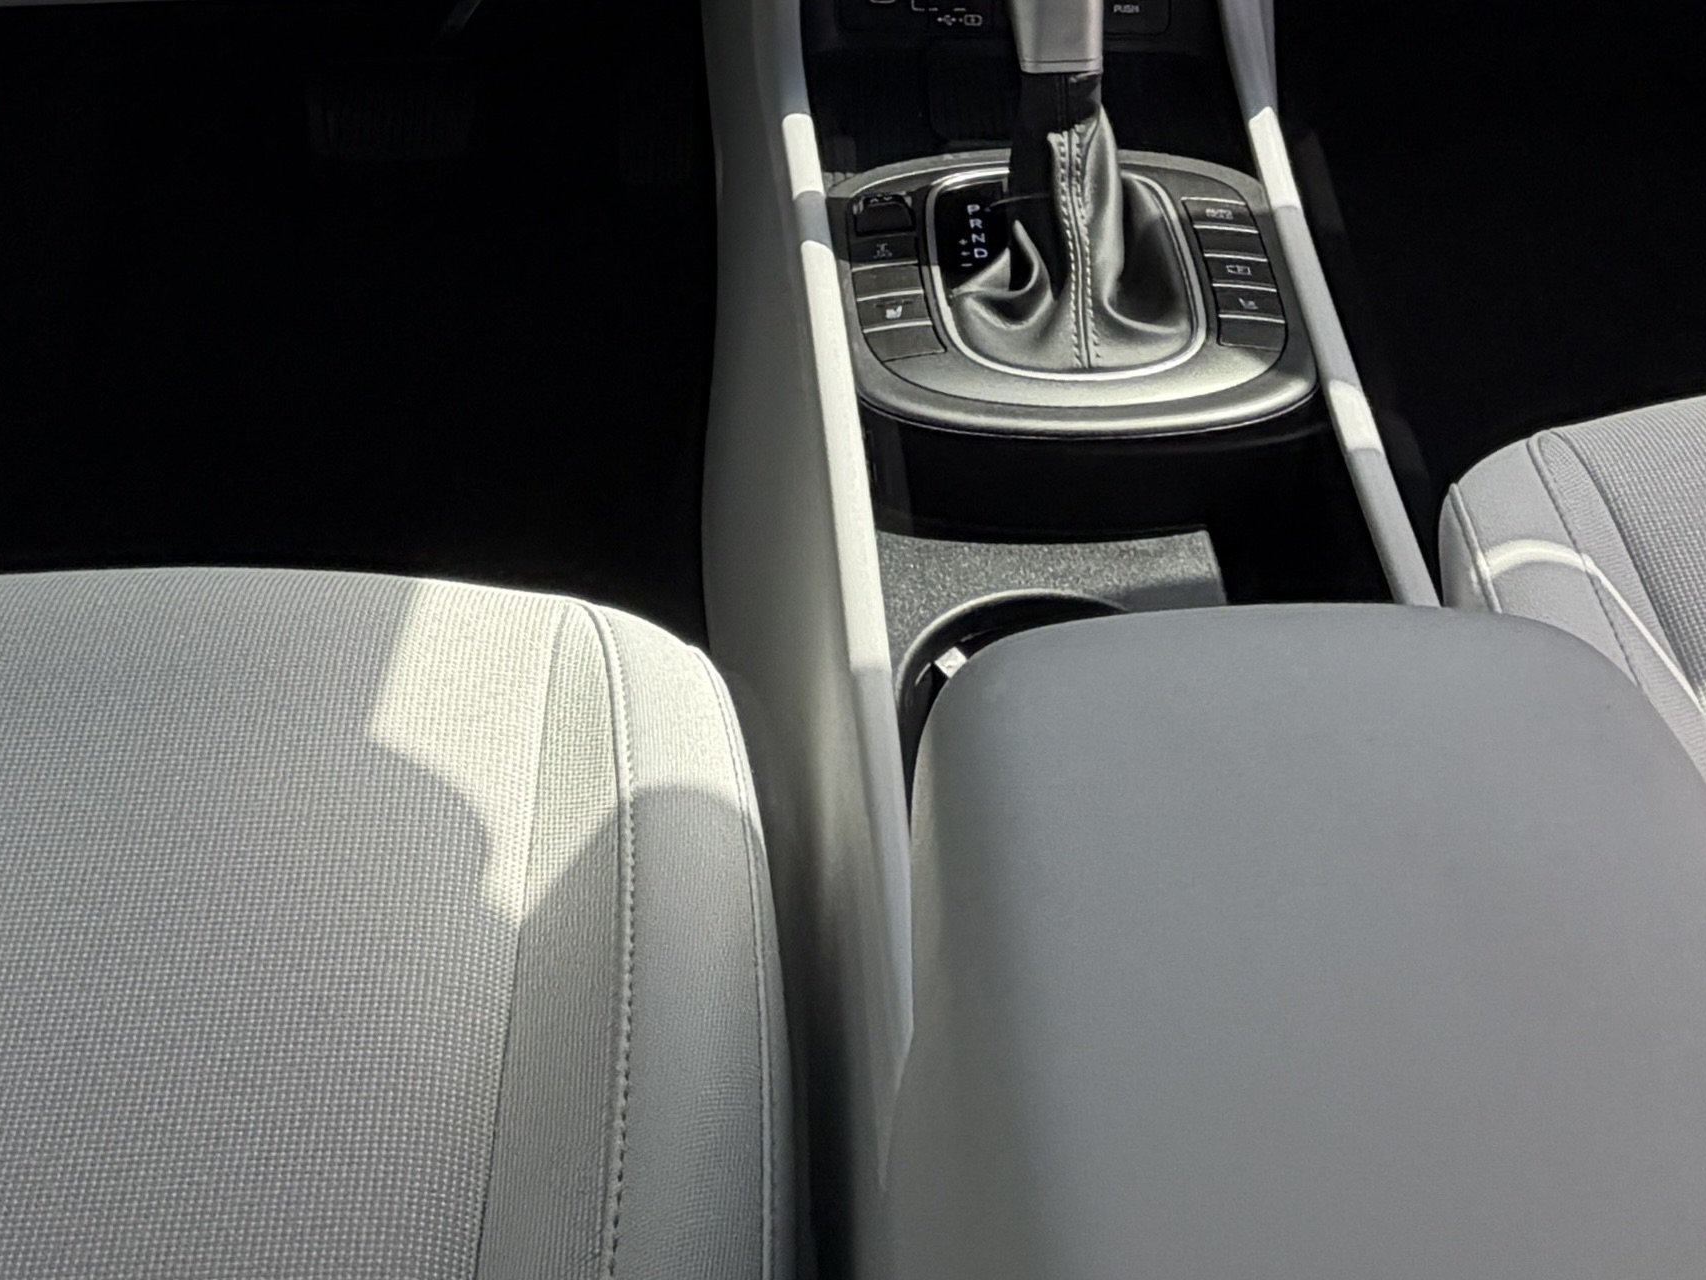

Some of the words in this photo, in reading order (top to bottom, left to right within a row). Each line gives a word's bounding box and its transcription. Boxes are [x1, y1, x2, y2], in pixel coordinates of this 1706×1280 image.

[1113, 4, 1140, 14] PUSH
[966, 204, 981, 215] P
[969, 218, 983, 229] R
[971, 232, 986, 243] N
[973, 247, 989, 258] D
